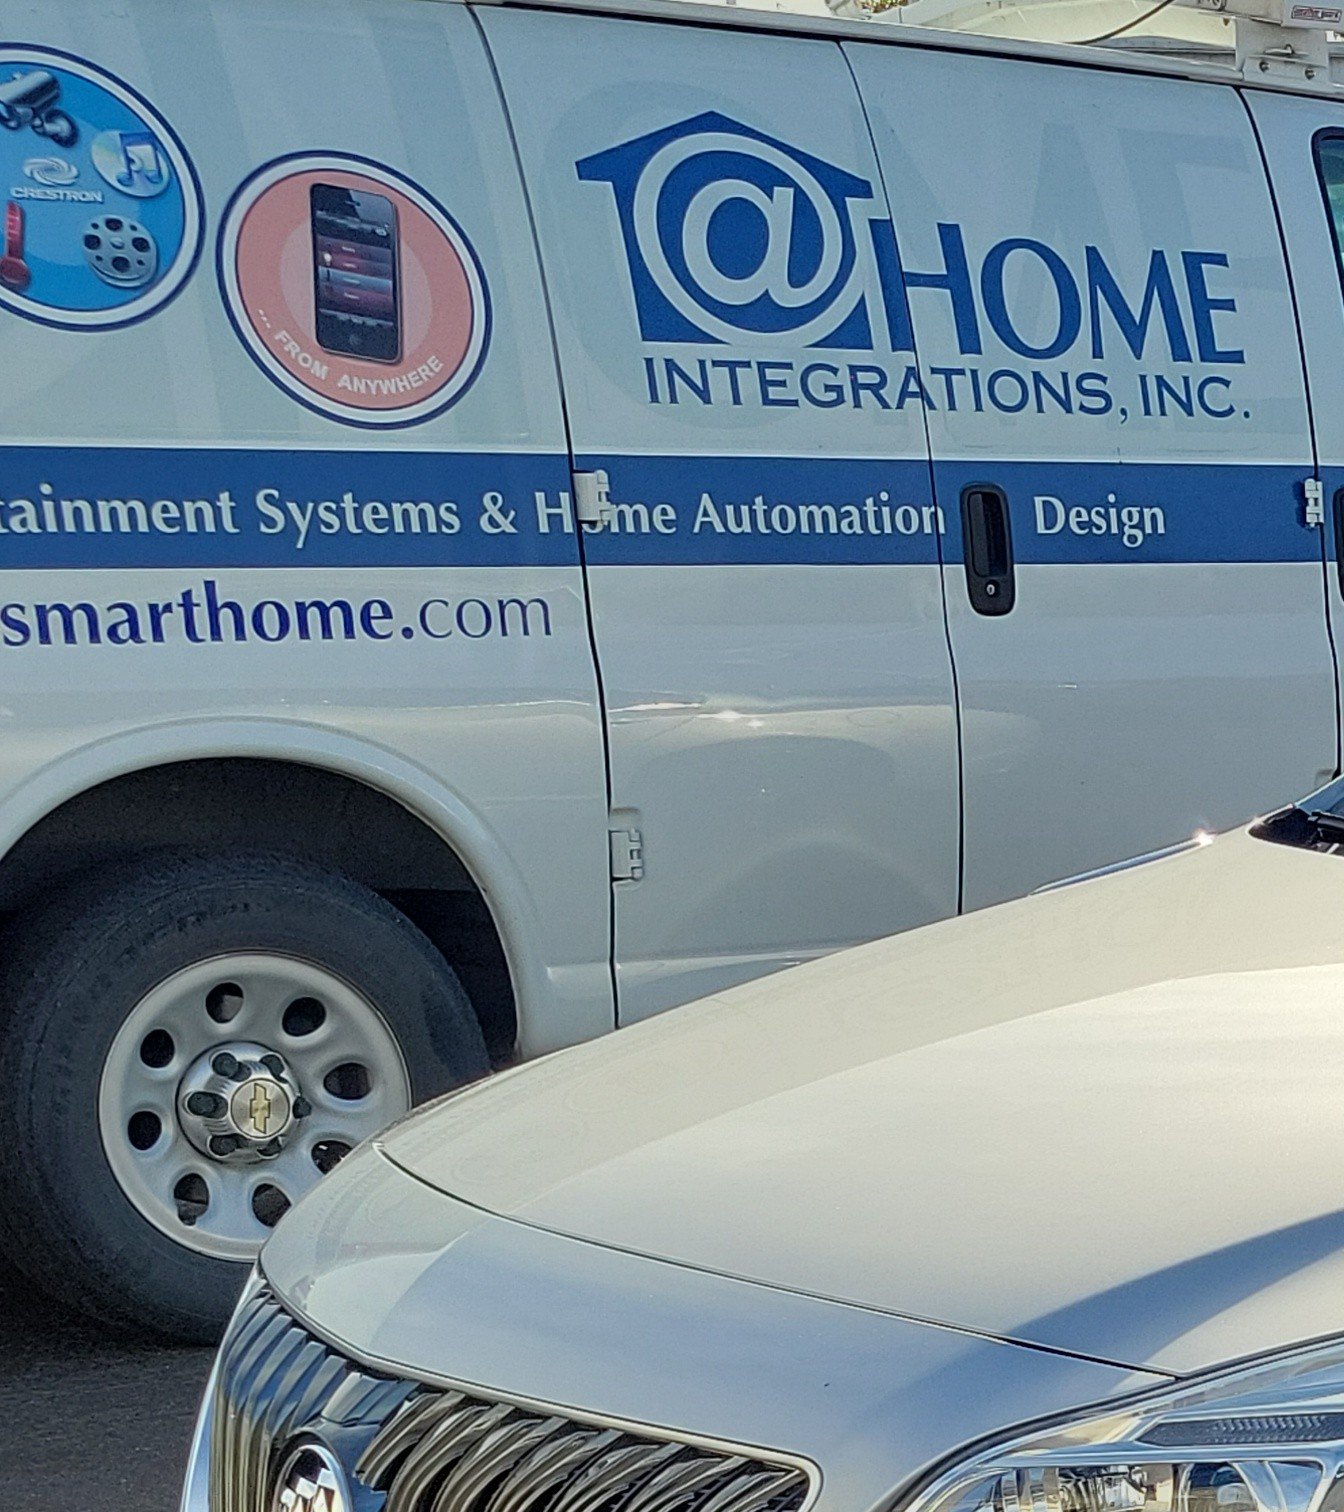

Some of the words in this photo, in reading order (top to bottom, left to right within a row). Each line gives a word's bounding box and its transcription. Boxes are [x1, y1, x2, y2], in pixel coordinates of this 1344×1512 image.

[11, 186, 103, 203] CRESTRON
[274, 329, 329, 380] FROM
[337, 355, 444, 395] ANYWHERE
[642, 356, 1129, 426] INTEGRATIONS,
[1139, 373, 1251, 420] INC.
[256, 488, 460, 548] Systems
[480, 491, 518, 534] &
[535, 490, 678, 535] Hme
[692, 491, 946, 535] Automation
[1034, 495, 1166, 548] Design
[0, 579, 552, 646] smarthome.com
